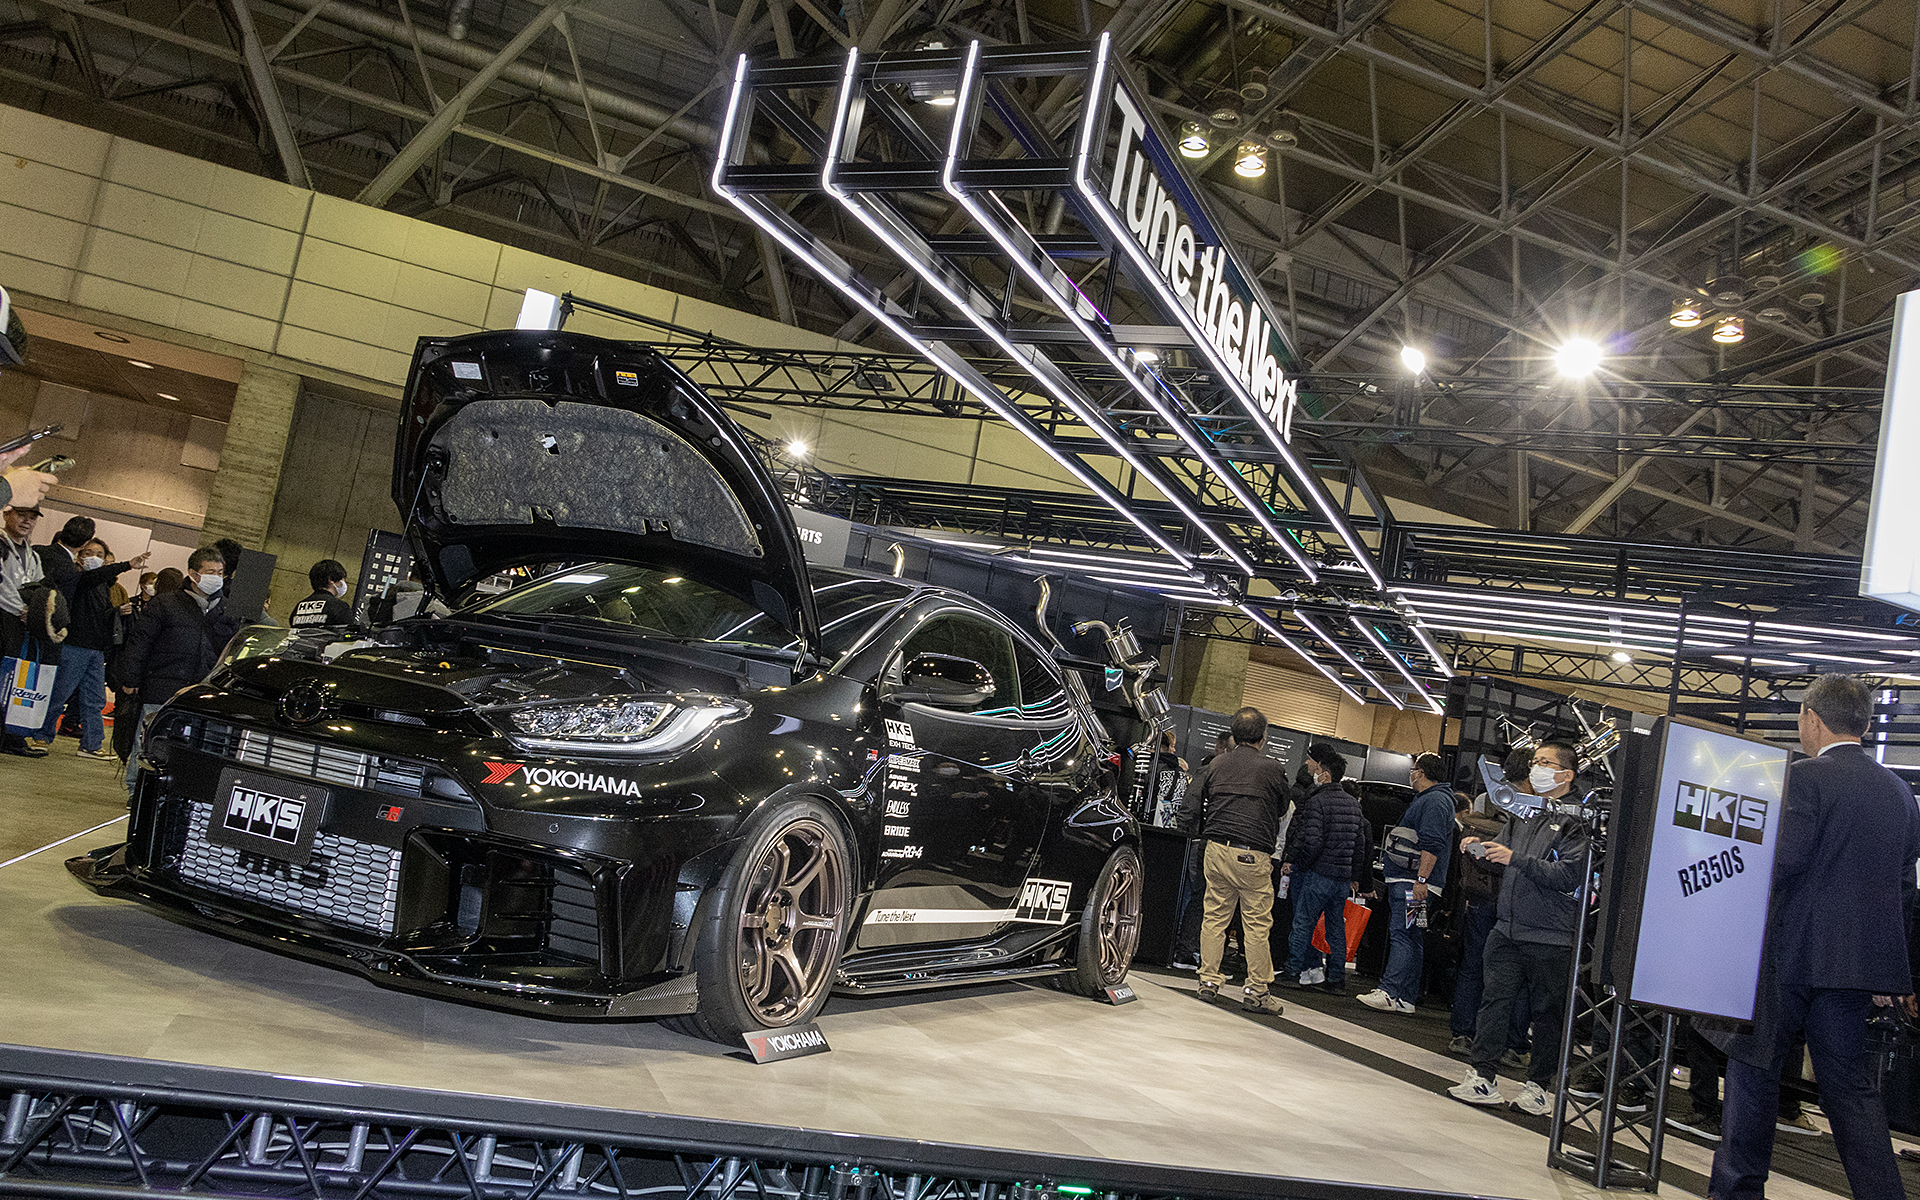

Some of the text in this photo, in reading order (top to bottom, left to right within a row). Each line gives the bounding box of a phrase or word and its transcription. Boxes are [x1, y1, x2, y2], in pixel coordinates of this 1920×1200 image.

[1110, 82, 1298, 444] Tune the Next
[298, 601, 324, 611] HKS
[886, 720, 912, 738] HKS
[522, 766, 642, 798] YOKOHAMA
[228, 790, 303, 831] HKS
[886, 800, 911, 814] ENDLESS
[1676, 784, 1767, 830] HKS
[884, 825, 911, 837] BRIDE
[1677, 845, 1745, 898] RZ350S
[1018, 883, 1070, 911] HKS
[875, 910, 916, 922] Tune the Next
[767, 1030, 826, 1053] YOKOHAMA
